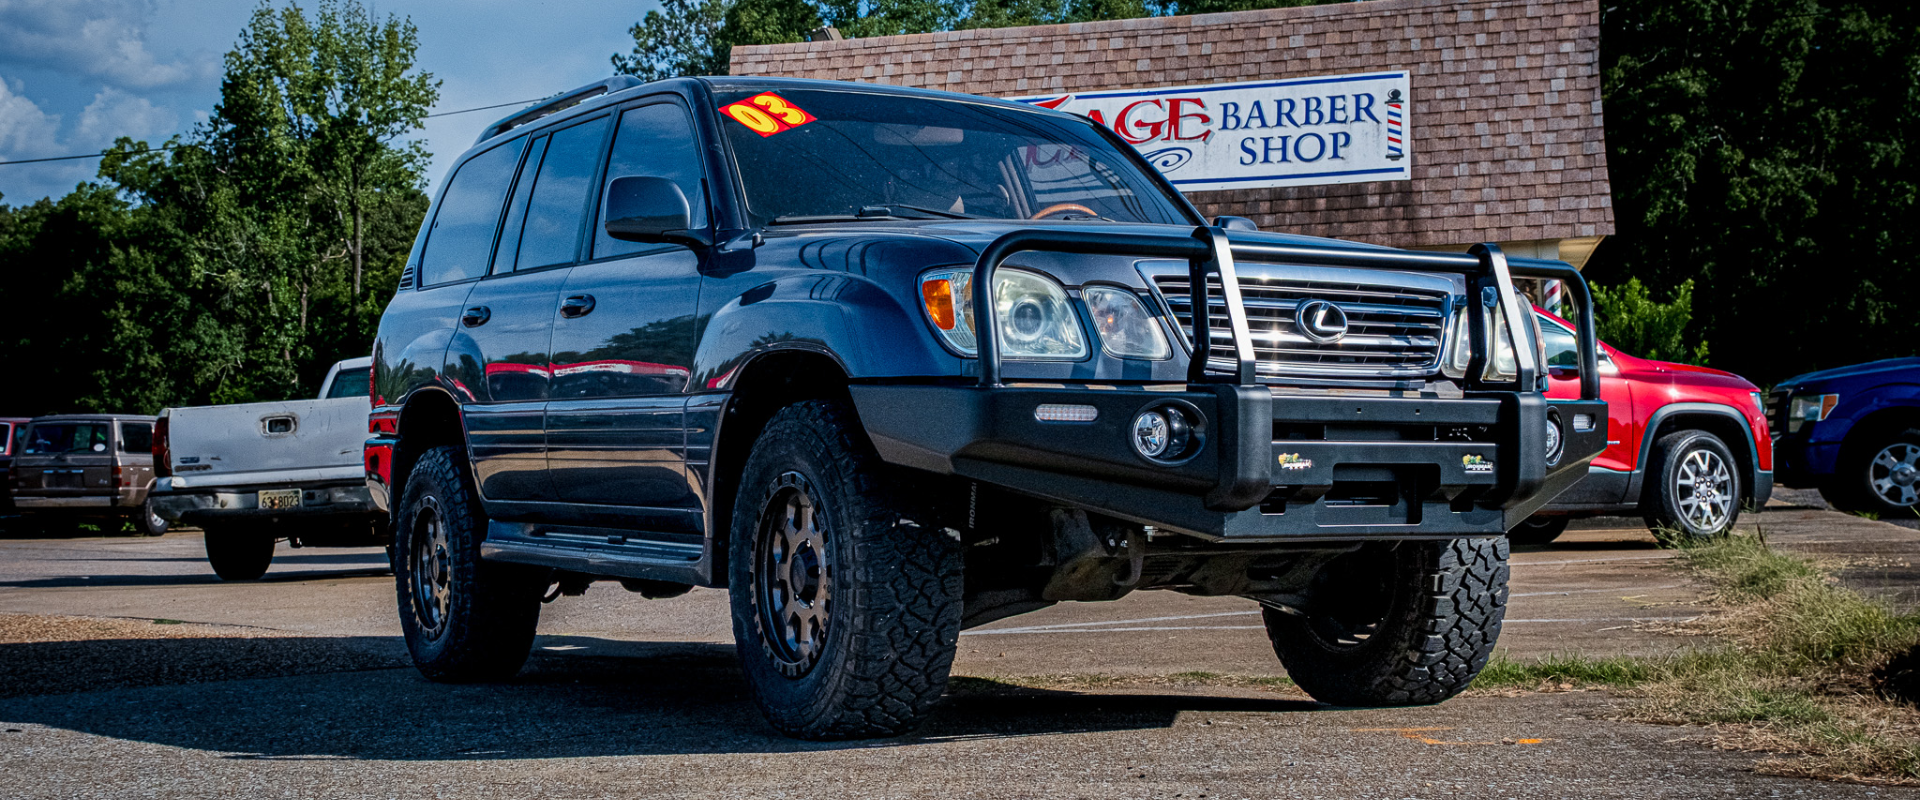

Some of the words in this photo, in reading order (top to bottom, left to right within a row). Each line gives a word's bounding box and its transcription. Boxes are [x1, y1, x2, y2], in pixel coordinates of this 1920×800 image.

[728, 95, 806, 133] 03
[1218, 92, 1382, 131] BARBER
[1239, 131, 1351, 166] SHOP
